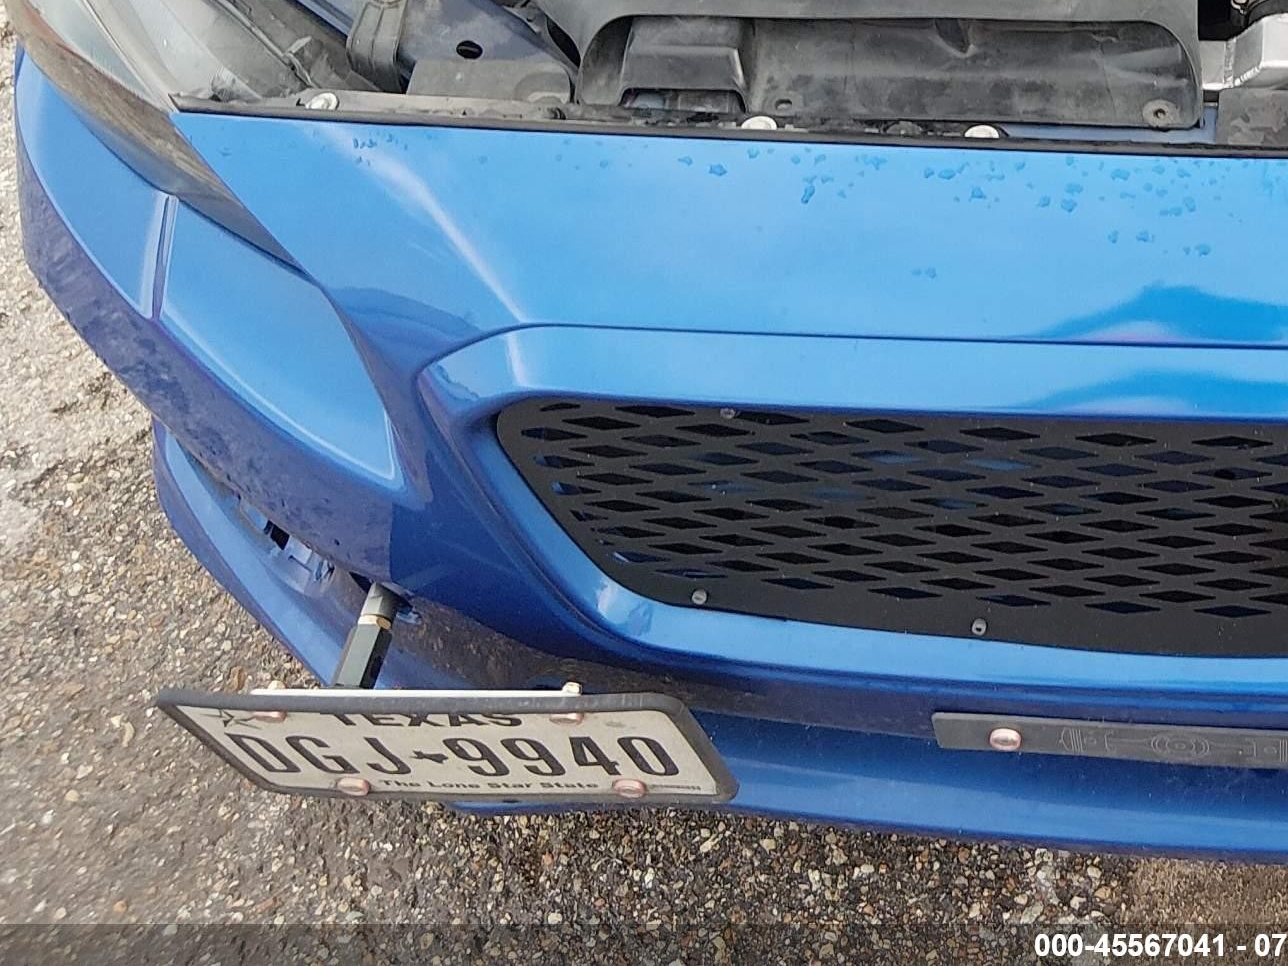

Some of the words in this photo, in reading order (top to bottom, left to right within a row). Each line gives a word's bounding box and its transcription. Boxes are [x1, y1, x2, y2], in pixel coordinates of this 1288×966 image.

[382, 779, 421, 788] The
[426, 780, 481, 789] Lone
[486, 781, 533, 790] Star
[539, 781, 600, 790] State
